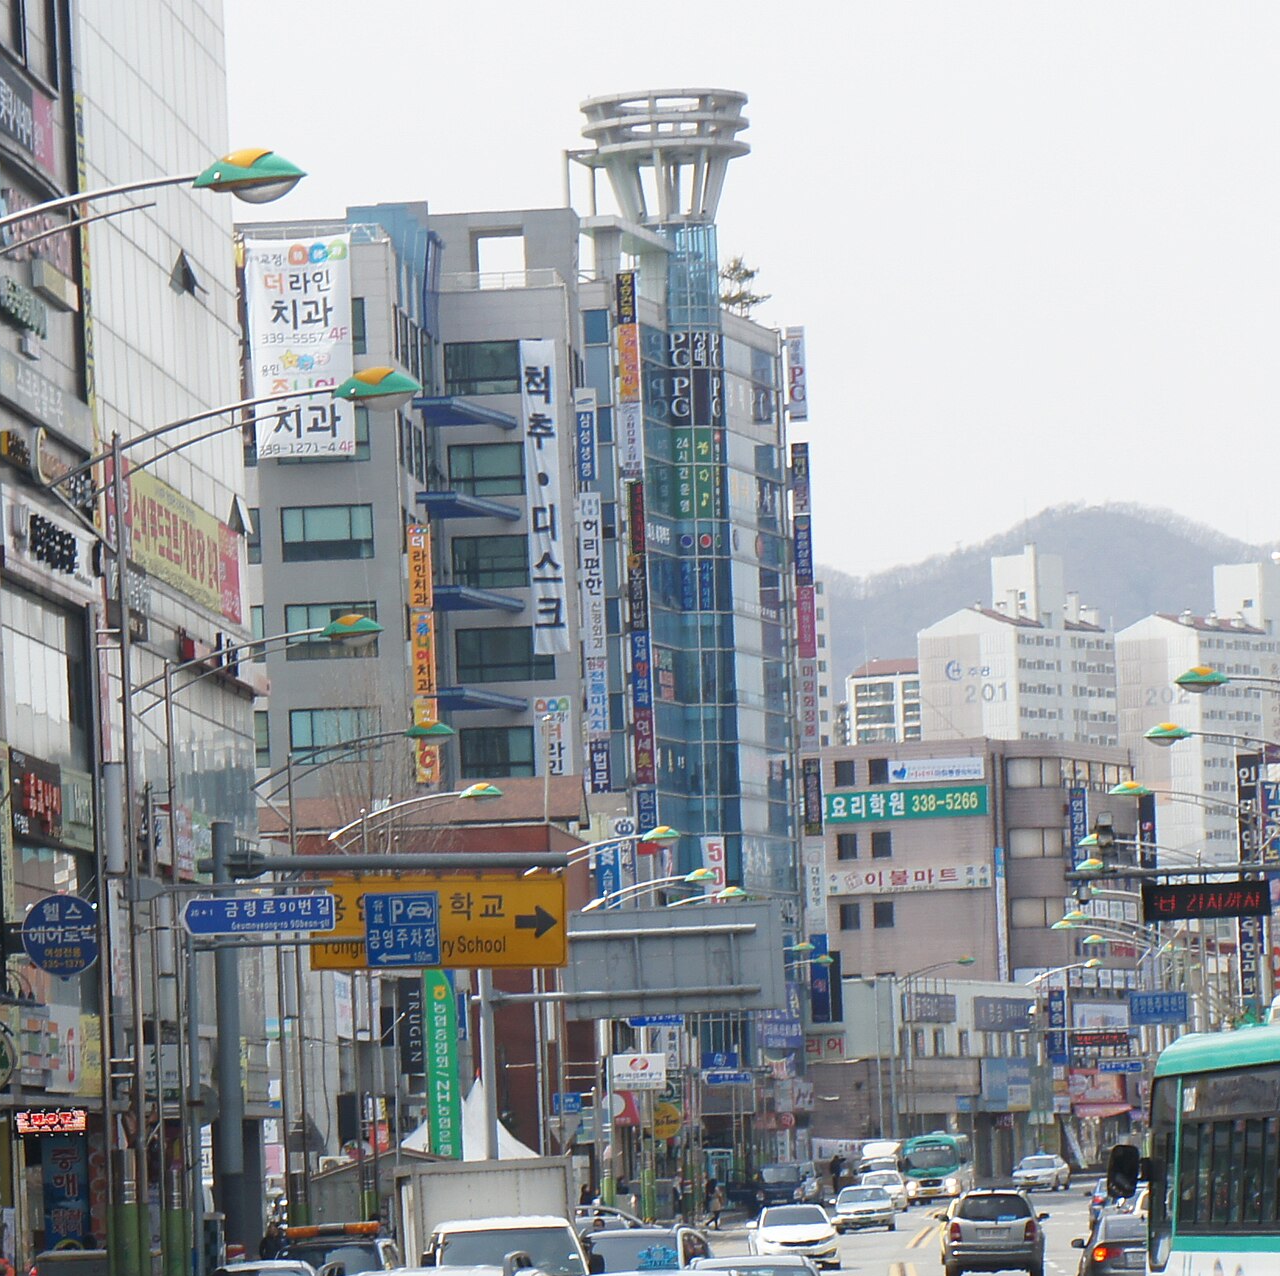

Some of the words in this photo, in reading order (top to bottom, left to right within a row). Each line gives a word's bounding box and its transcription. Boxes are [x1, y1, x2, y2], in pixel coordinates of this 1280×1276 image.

[271, 297, 333, 330] 치과
[329, 327, 348, 341] 4F
[672, 377, 690, 417] PC
[789, 367, 805, 401] PC
[273, 404, 341, 438] 치과
[583, 519, 603, 597] 허리편한
[823, 792, 906, 819] 요리학원
[369, 928, 437, 949] 공영주차장
[458, 936, 506, 953] School
[408, 990, 422, 1064] TRUGEN
